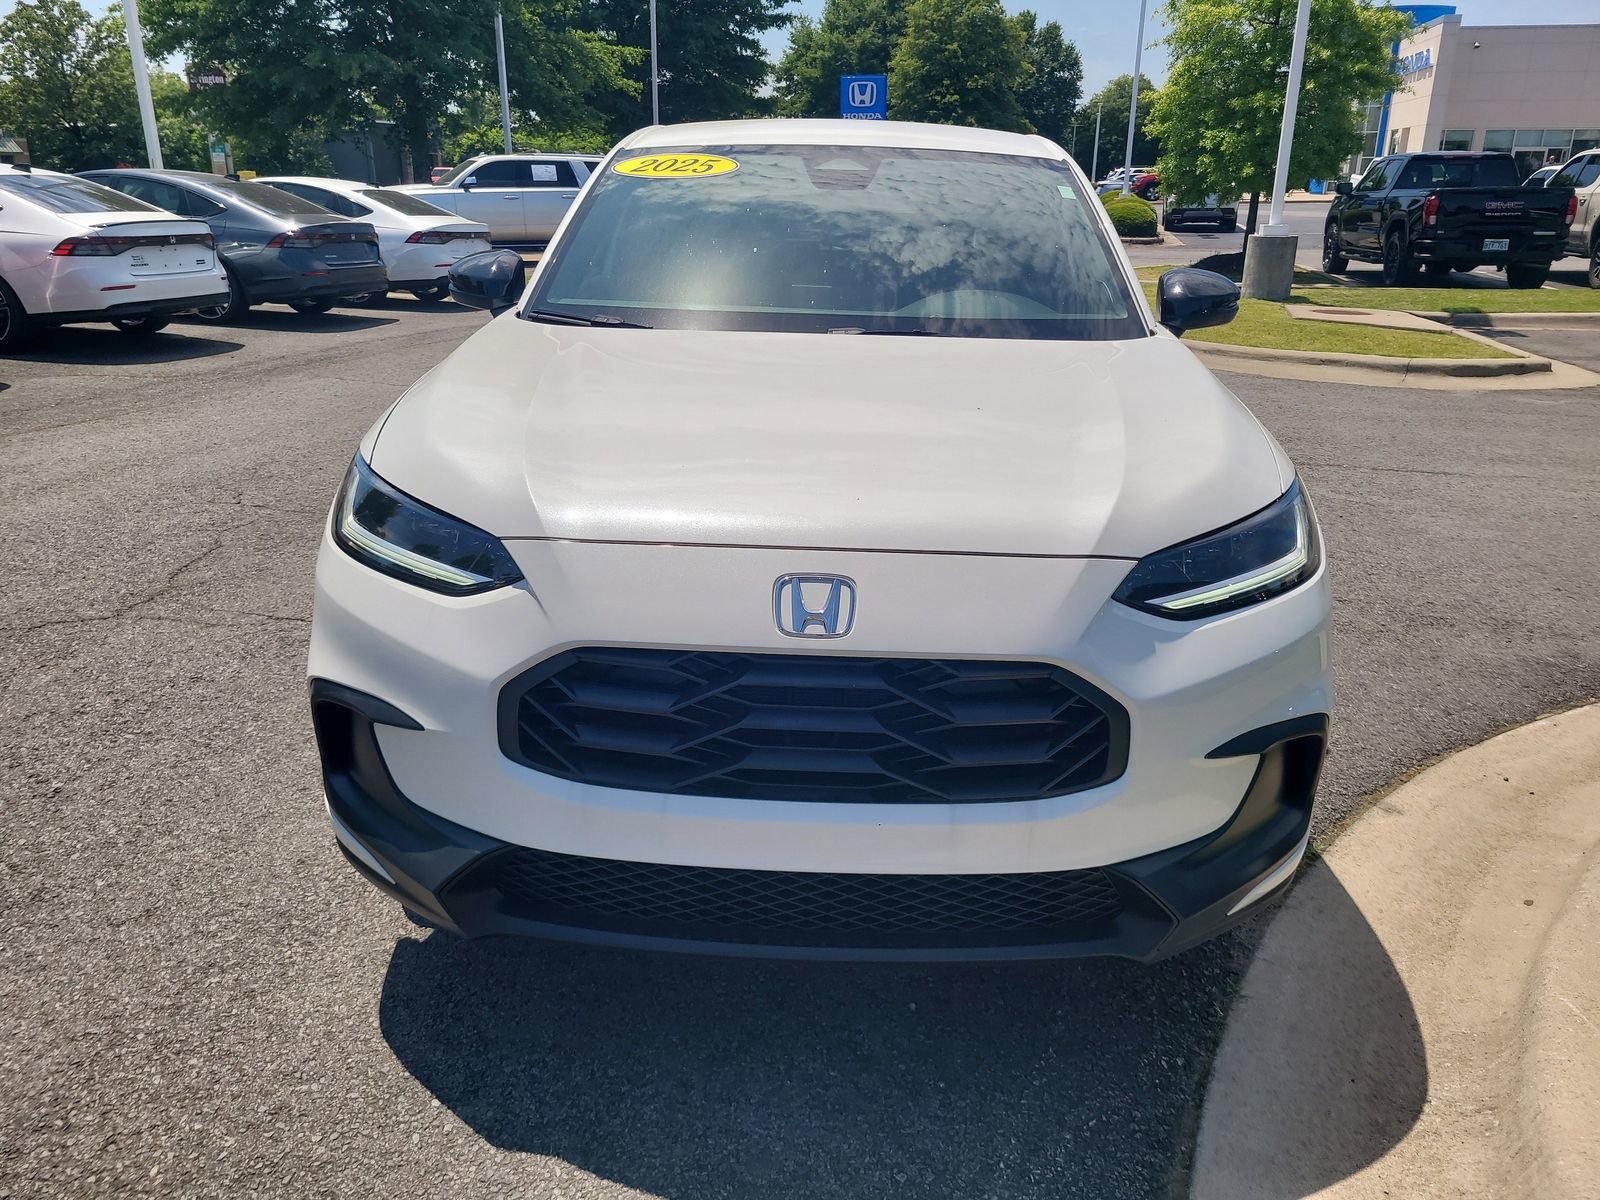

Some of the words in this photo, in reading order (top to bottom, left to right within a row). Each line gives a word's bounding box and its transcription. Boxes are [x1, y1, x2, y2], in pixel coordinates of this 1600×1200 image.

[1396, 48, 1432, 76] ONDA
[843, 112, 882, 120] HONDA
[629, 158, 721, 173] 2025
[1485, 201, 1525, 210] GMC
